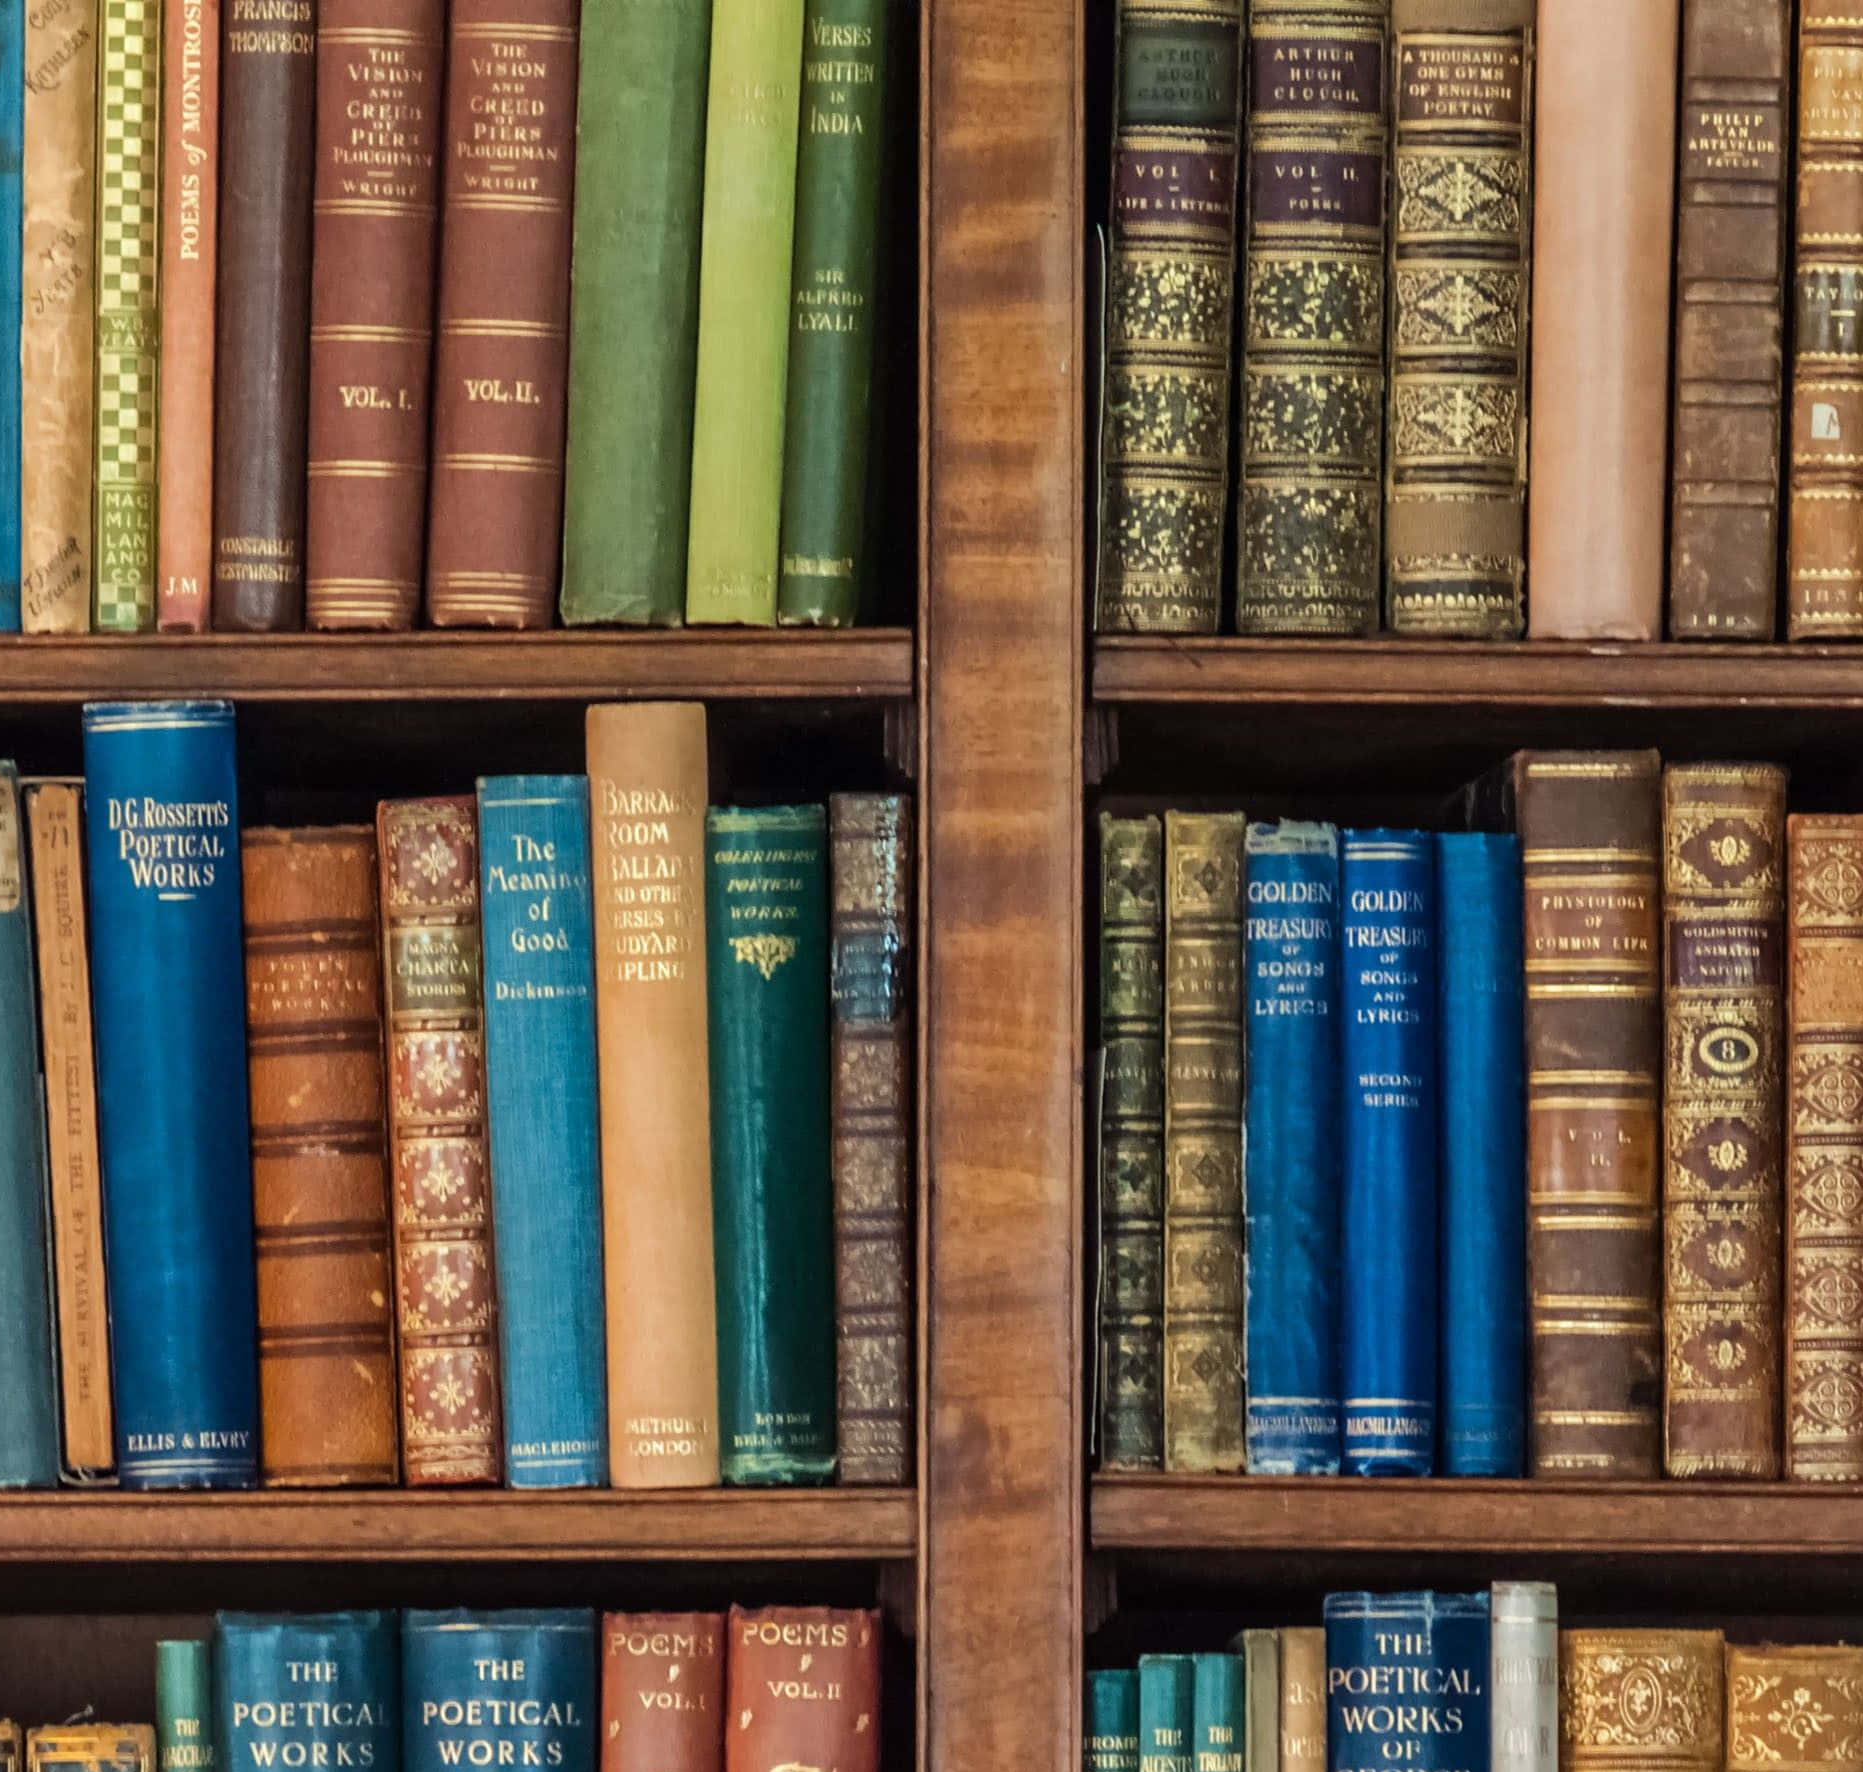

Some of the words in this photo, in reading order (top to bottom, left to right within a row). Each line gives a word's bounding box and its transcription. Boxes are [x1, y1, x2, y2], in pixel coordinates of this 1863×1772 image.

[230, 31, 315, 54] THOMPSON
[1438, 84, 1512, 100] ENGLISH
[810, 111, 863, 134] INDIA
[188, 140, 207, 165] of
[457, 142, 557, 160] PLOUGHMAN
[180, 172, 200, 260] POEMS
[120, 830, 224, 860] POETICAL
[513, 835, 555, 862] The
[129, 860, 216, 889] WORKS
[1248, 881, 1332, 904] GOLDEN
[511, 927, 569, 953] Good
[1612, 936, 1648, 950] LIFE
[1257, 960, 1324, 978] SONGS
[742, 1623, 847, 1647] POEMS
[1375, 1634, 1431, 1655] THE
[475, 1659, 524, 1681] THE
[1329, 1668, 1480, 1695] POETICAL
[828, 1681, 841, 1700] II
[423, 1701, 580, 1726] POETICAL
[1342, 1707, 1463, 1733] WORKS
[438, 1740, 563, 1765] WORKS
[1383, 1740, 1421, 1759] OF
